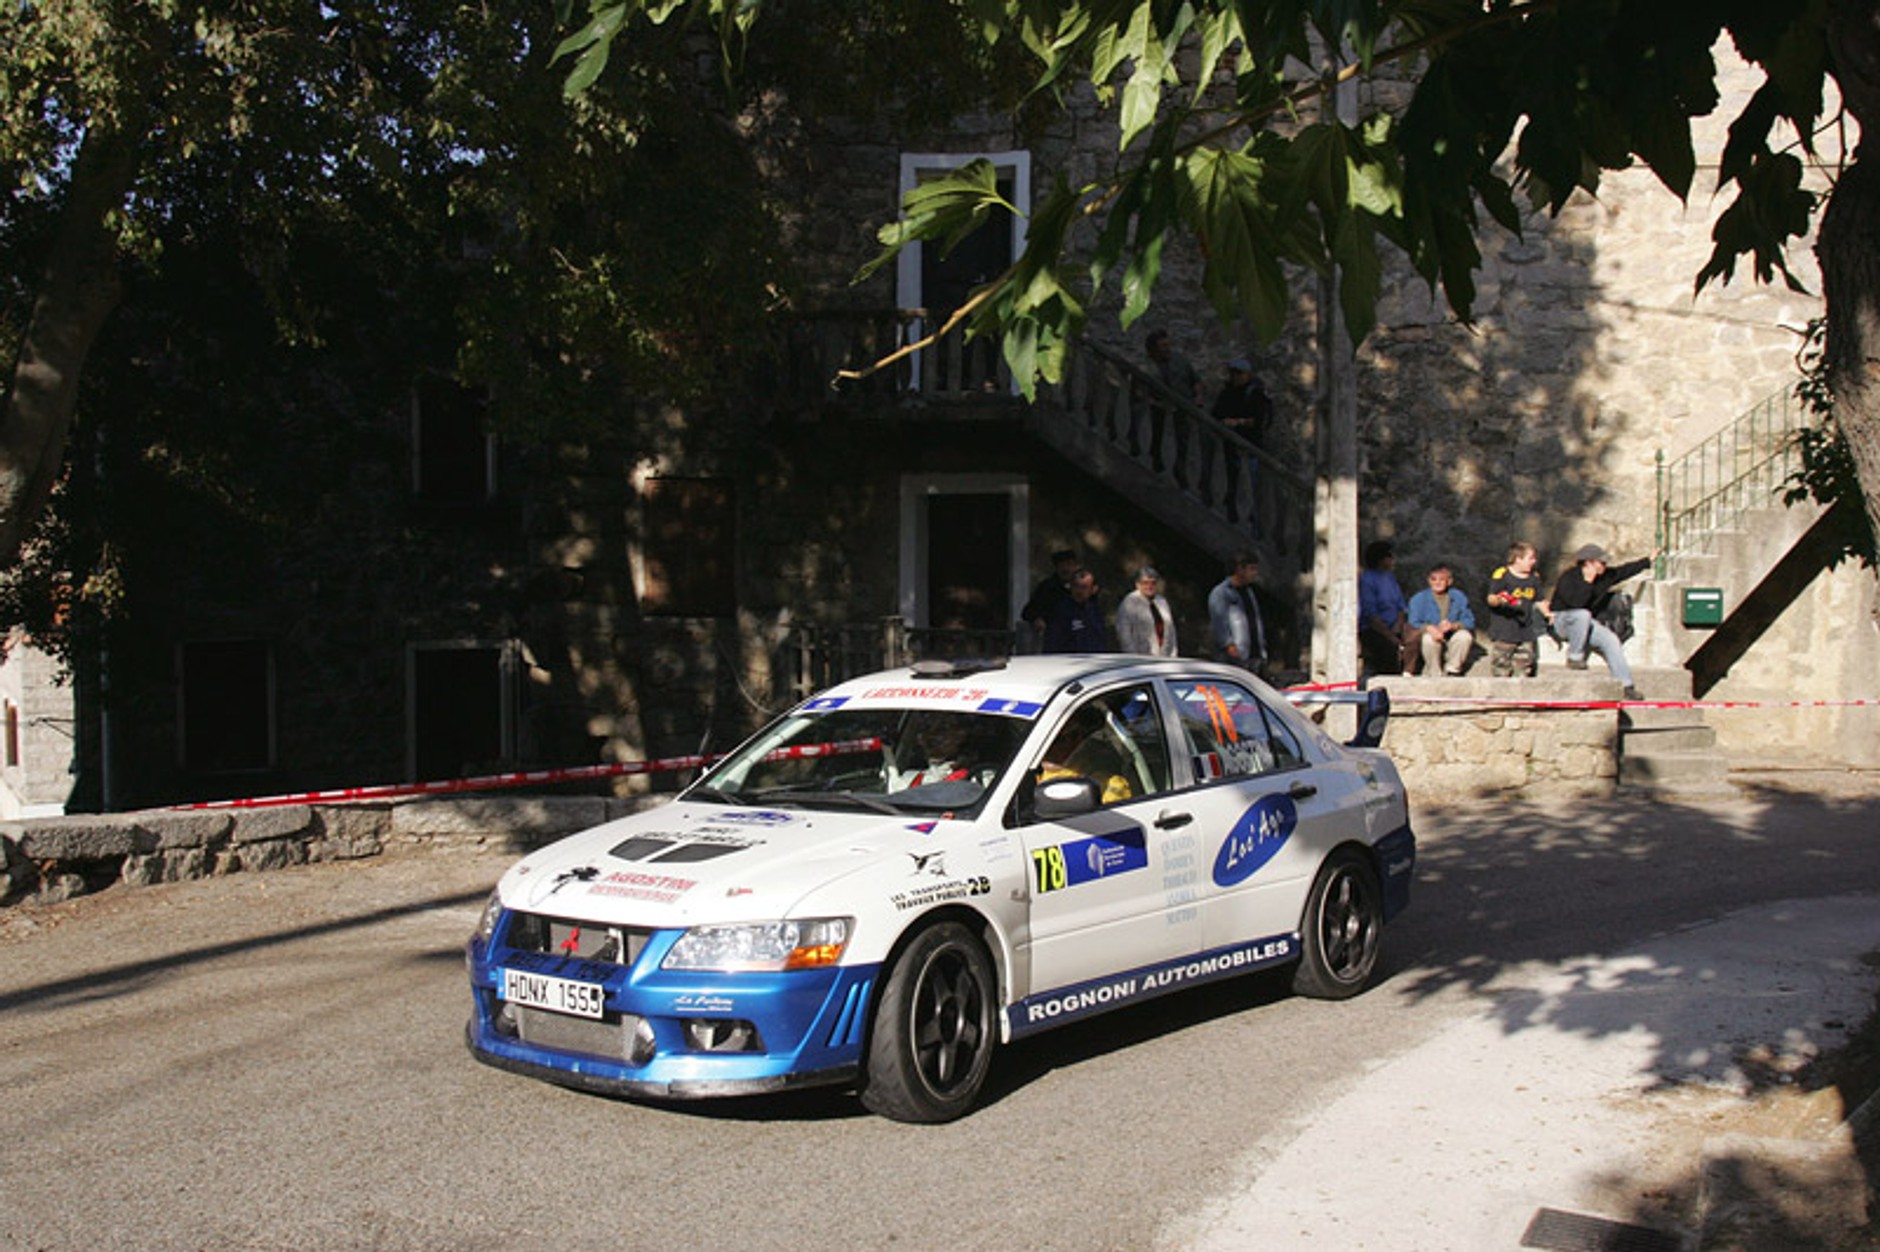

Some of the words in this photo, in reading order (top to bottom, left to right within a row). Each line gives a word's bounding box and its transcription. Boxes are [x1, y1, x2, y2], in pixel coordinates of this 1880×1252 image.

[968, 876, 991, 896] 2B
[1032, 847, 1065, 892] 78
[1028, 980, 1137, 1022] ROGNONI
[1142, 940, 1289, 991] AUTOMOBILES
